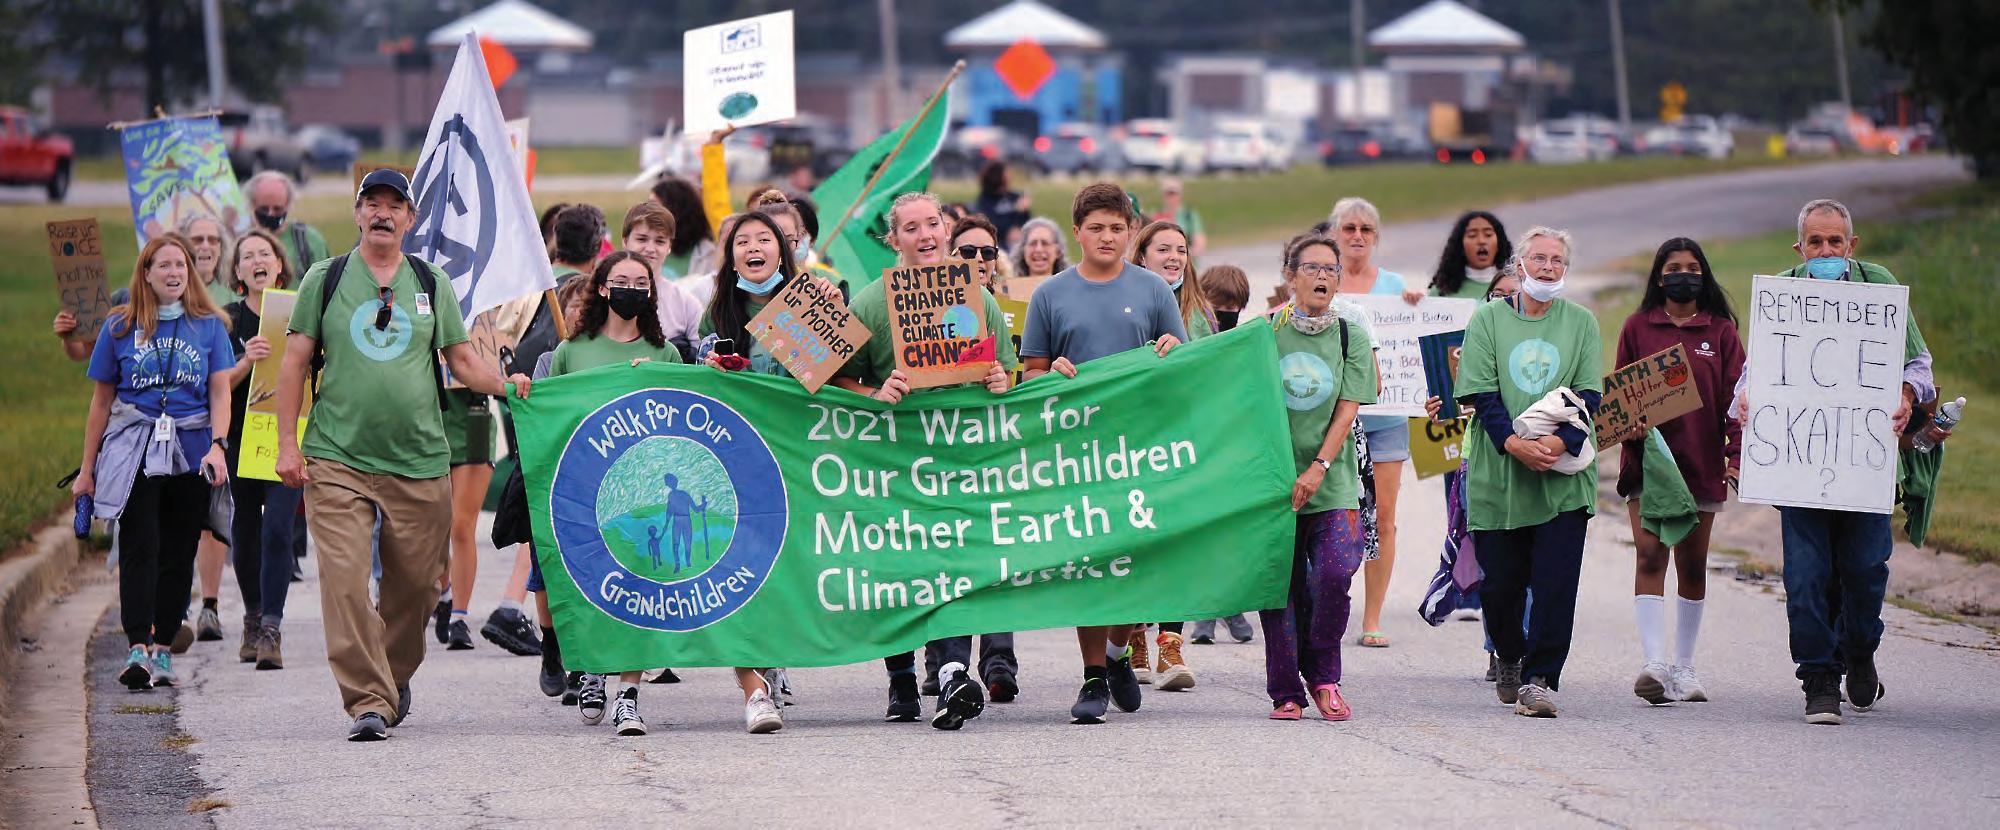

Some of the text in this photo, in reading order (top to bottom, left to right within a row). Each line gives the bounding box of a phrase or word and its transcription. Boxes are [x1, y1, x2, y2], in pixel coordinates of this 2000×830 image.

[890, 263, 971, 291] SYSTEM
[790, 272, 850, 328] Respect
[894, 288, 966, 312] CHANGE
[1373, 310, 1454, 323] President Biden
[1759, 290, 1897, 329] REMEMBER
[784, 291, 854, 360] ur MOTHER
[898, 312, 934, 328] NOT
[902, 323, 956, 343] CLIMATE
[156, 337, 186, 350] EVERY
[184, 345, 201, 364] DAY
[1769, 332, 1888, 390] ICE
[176, 369, 202, 387] Day
[1603, 348, 1681, 396] ARTH IS
[1379, 385, 1409, 404] ATE
[1591, 378, 1662, 418] ing Hotter
[588, 399, 732, 458] Walk for Our
[807, 396, 1101, 446] 2021 Walk for
[1608, 411, 1629, 426] my
[1747, 405, 1888, 470] SKATES
[811, 435, 1197, 498] Our Grandchildren
[1443, 444, 1460, 461] IS
[1819, 467, 1836, 498] ?
[815, 489, 1156, 555] Mother Earth &
[818, 567, 973, 613] Climate
